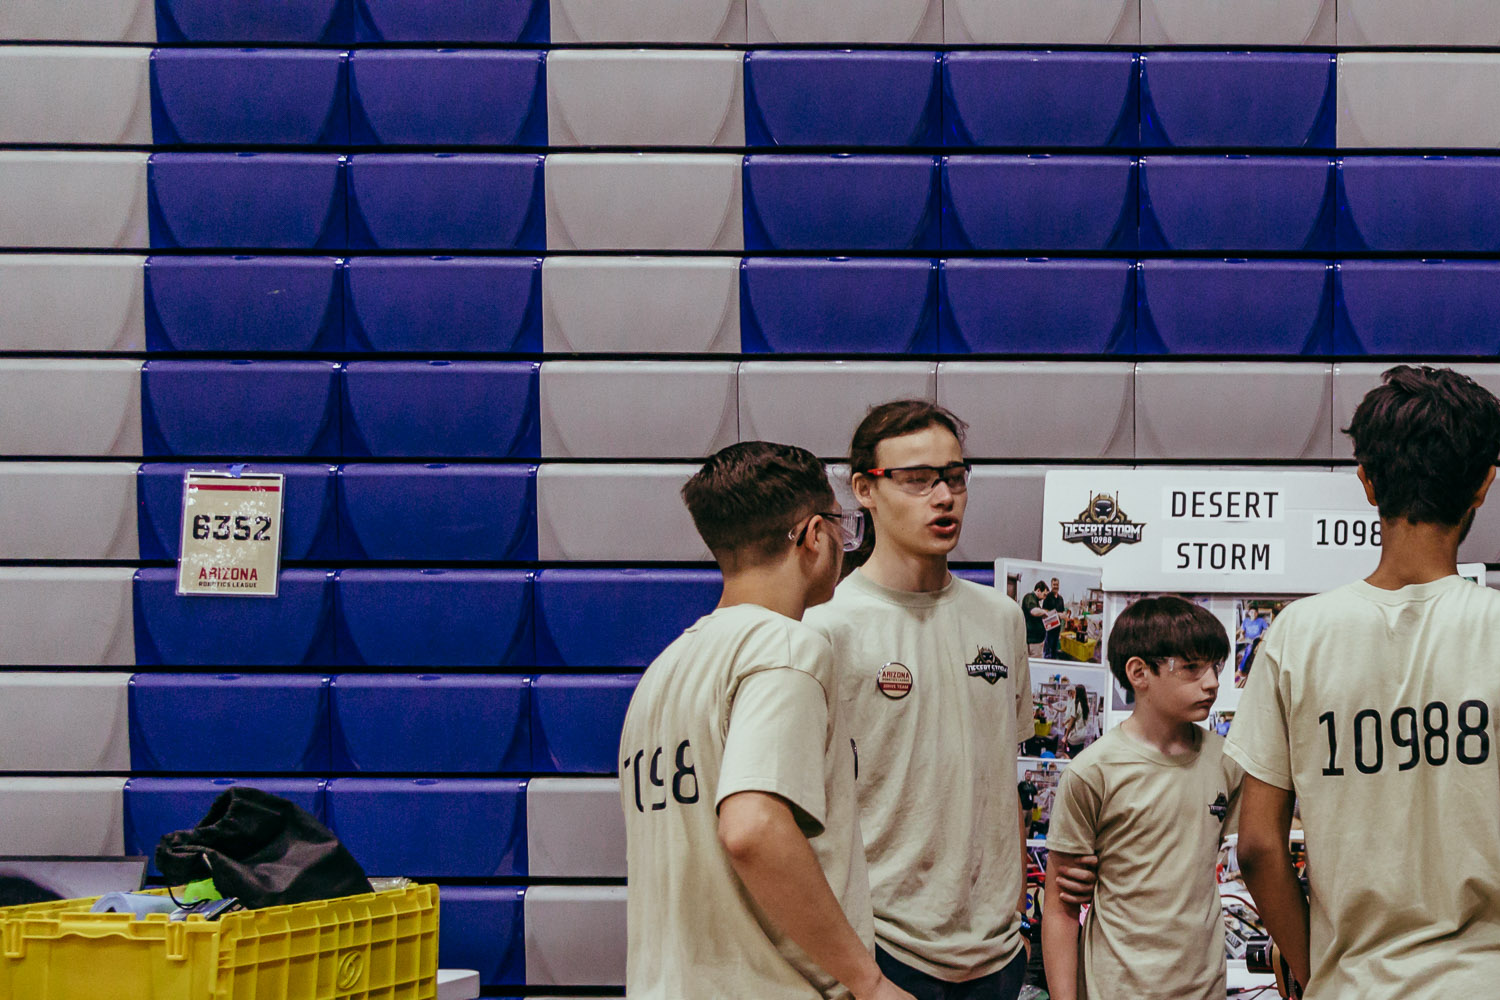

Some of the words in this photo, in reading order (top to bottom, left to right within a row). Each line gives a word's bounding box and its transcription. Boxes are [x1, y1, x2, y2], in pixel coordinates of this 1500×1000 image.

[1171, 491, 1279, 518] DESERT
[192, 514, 272, 541] 6352
[1064, 523, 1104, 539] DESERT
[1105, 523, 1141, 540] STORM
[1091, 536, 1112, 544] 10988
[1177, 542, 1270, 570] STORM
[198, 567, 258, 581] ARIZONA
[882, 671, 909, 679] ARIZONA
[1318, 700, 1490, 776] 10988
